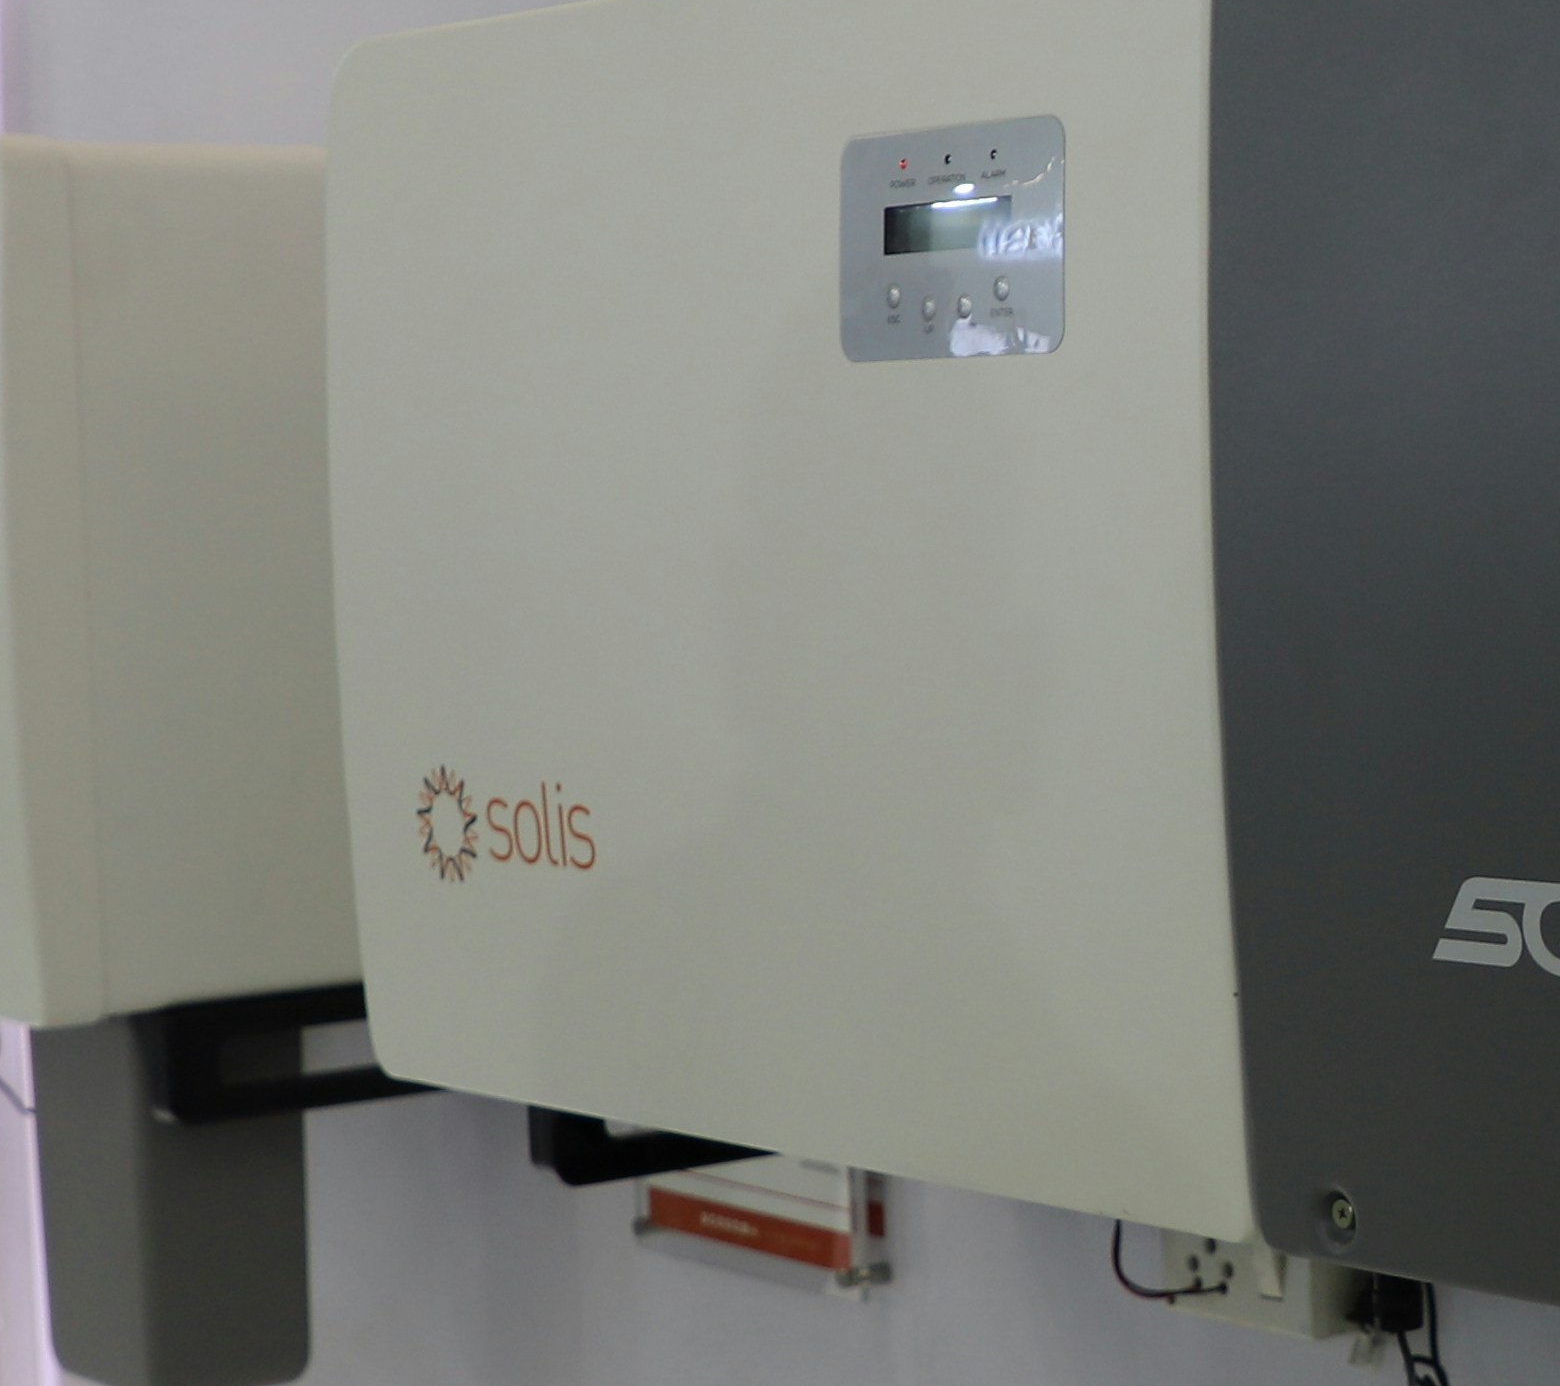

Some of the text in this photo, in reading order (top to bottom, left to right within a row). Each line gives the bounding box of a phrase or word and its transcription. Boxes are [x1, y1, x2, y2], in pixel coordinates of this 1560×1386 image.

[890, 169, 1006, 188] POWER OPERATION ALARM
[486, 781, 596, 870] solis
